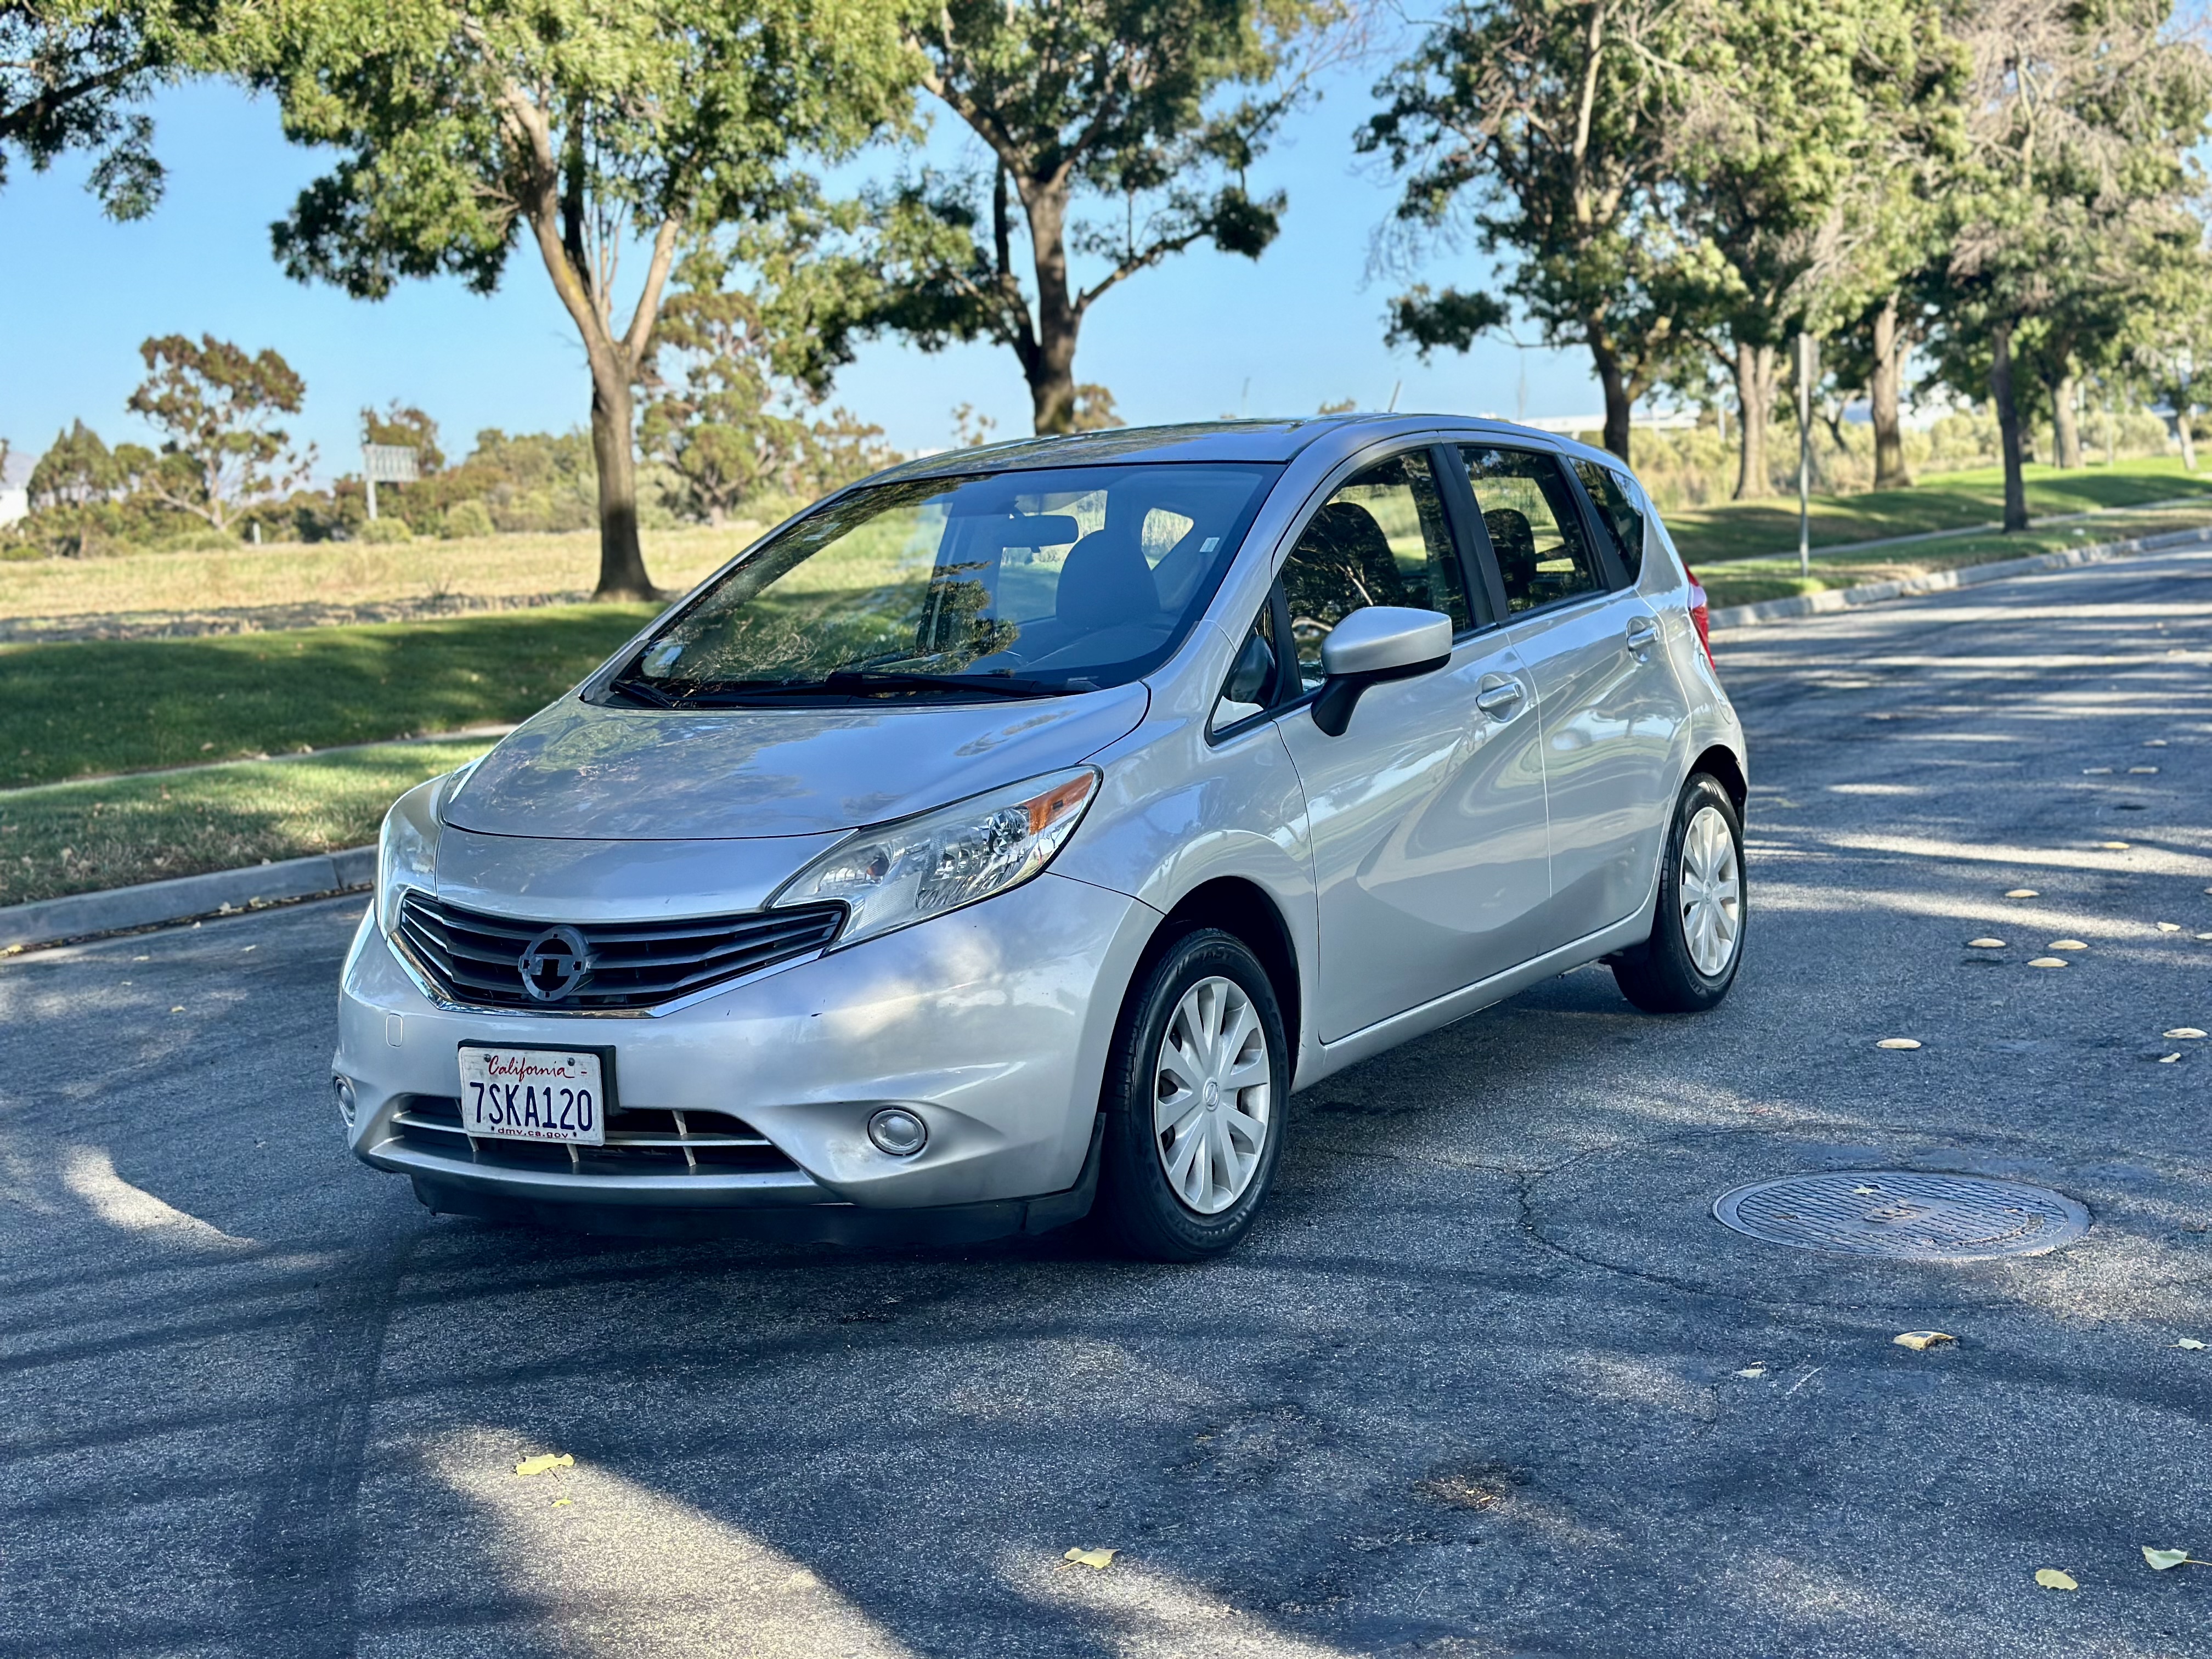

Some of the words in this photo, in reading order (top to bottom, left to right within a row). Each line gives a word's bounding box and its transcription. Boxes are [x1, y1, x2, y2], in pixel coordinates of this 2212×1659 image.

[488, 1055, 575, 1082] California
[470, 1081, 592, 1132] 7SKA120
[498, 1127, 568, 1139] dmv.ca.gov
